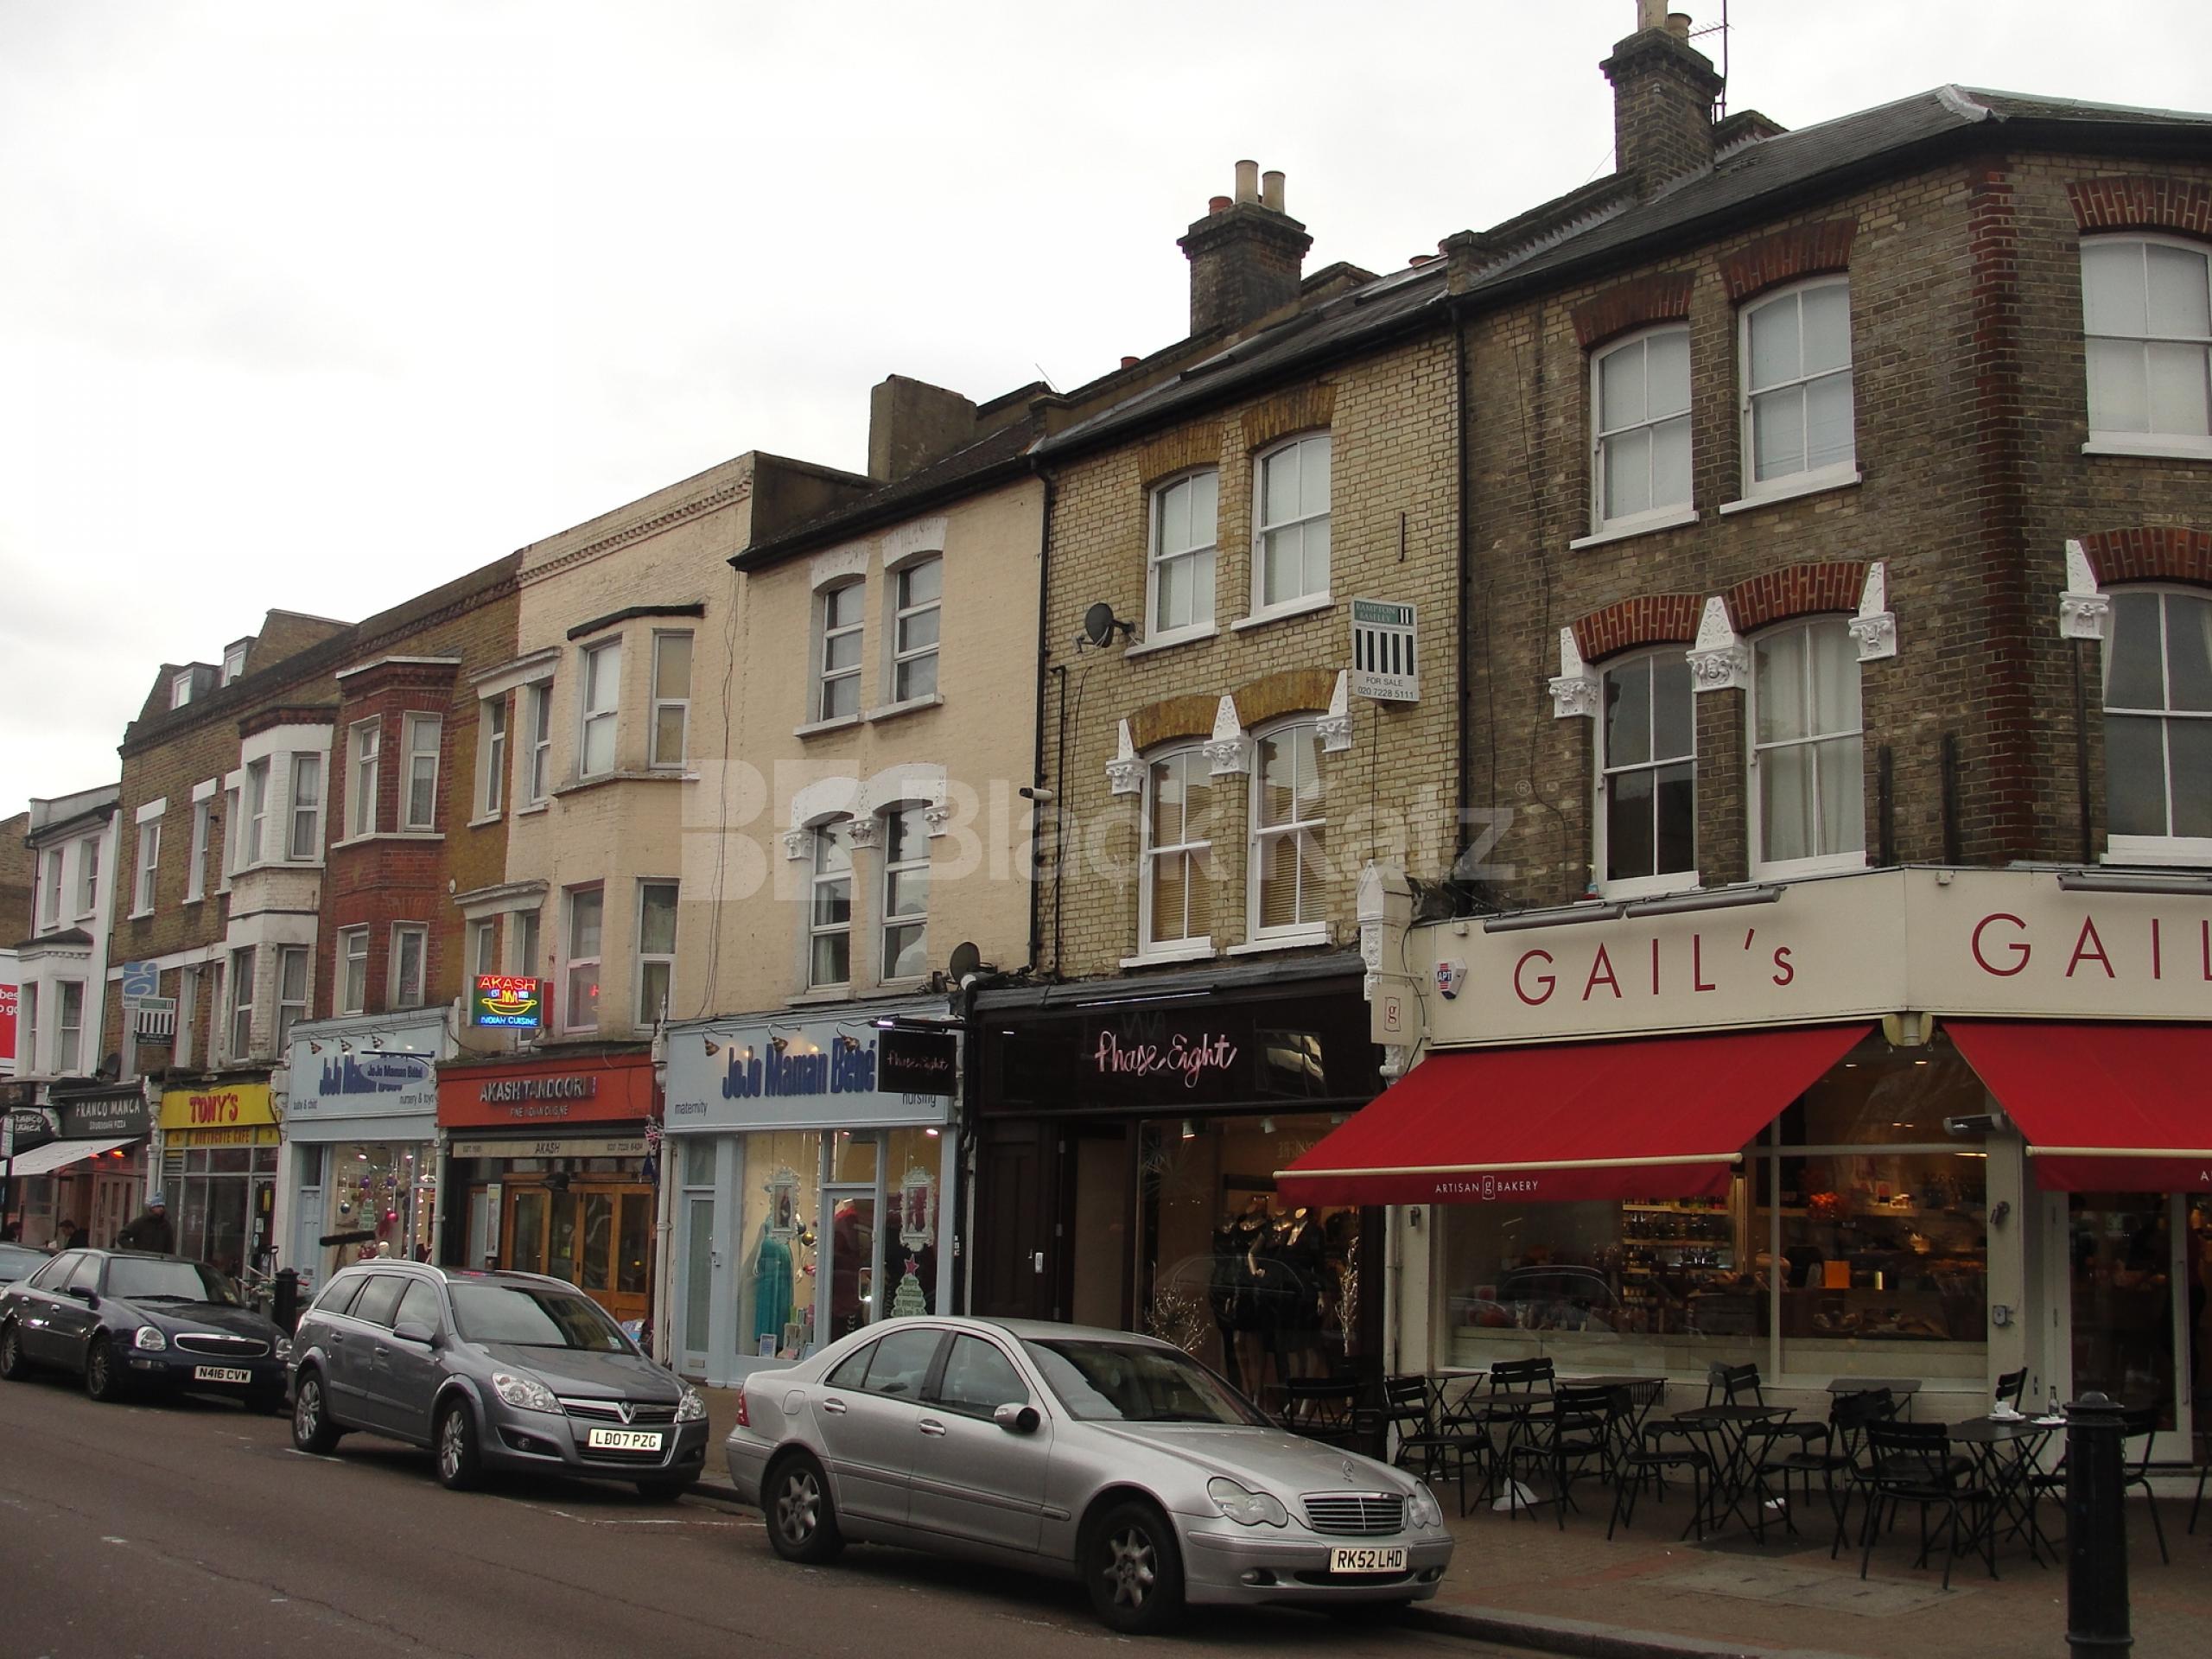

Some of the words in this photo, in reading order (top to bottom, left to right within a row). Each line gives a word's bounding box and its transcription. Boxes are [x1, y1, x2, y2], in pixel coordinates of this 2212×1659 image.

[1383, 677, 1403, 687] SALE
[1357, 685, 1371, 695] 020
[1373, 687, 1393, 697] 7228
[1394, 689, 1414, 699] 5111
[1514, 928, 1794, 1006] GAIL's
[480, 976, 537, 991] AKASH
[1437, 971, 1452, 982] APT
[480, 1015, 506, 1025] INDIAN
[508, 1016, 537, 1026] CUISINE
[1095, 1030, 1166, 1077] Phase
[1166, 1033, 1238, 1089] Eight
[722, 1046, 762, 1100] JoJo
[765, 1043, 829, 1097] Maman
[480, 1080, 520, 1103] AKASH
[524, 1077, 587, 1099] TANDOORI
[76, 1100, 108, 1118] FRANCO
[111, 1098, 141, 1116] MANCA
[189, 1093, 238, 1123] TONY'S
[675, 1100, 709, 1116] maternity
[902, 1093, 936, 1108] nursing
[534, 1141, 561, 1154] AKASH
[1435, 1182, 1479, 1194] ARTISAN
[1497, 1180, 1539, 1192] BAKERY
[199, 1367, 225, 1379] N416
[595, 1432, 630, 1446] LD07
[632, 1434, 657, 1448] PZG
[1338, 1549, 1376, 1569] RK52
[1377, 1548, 1402, 1567] LHD
